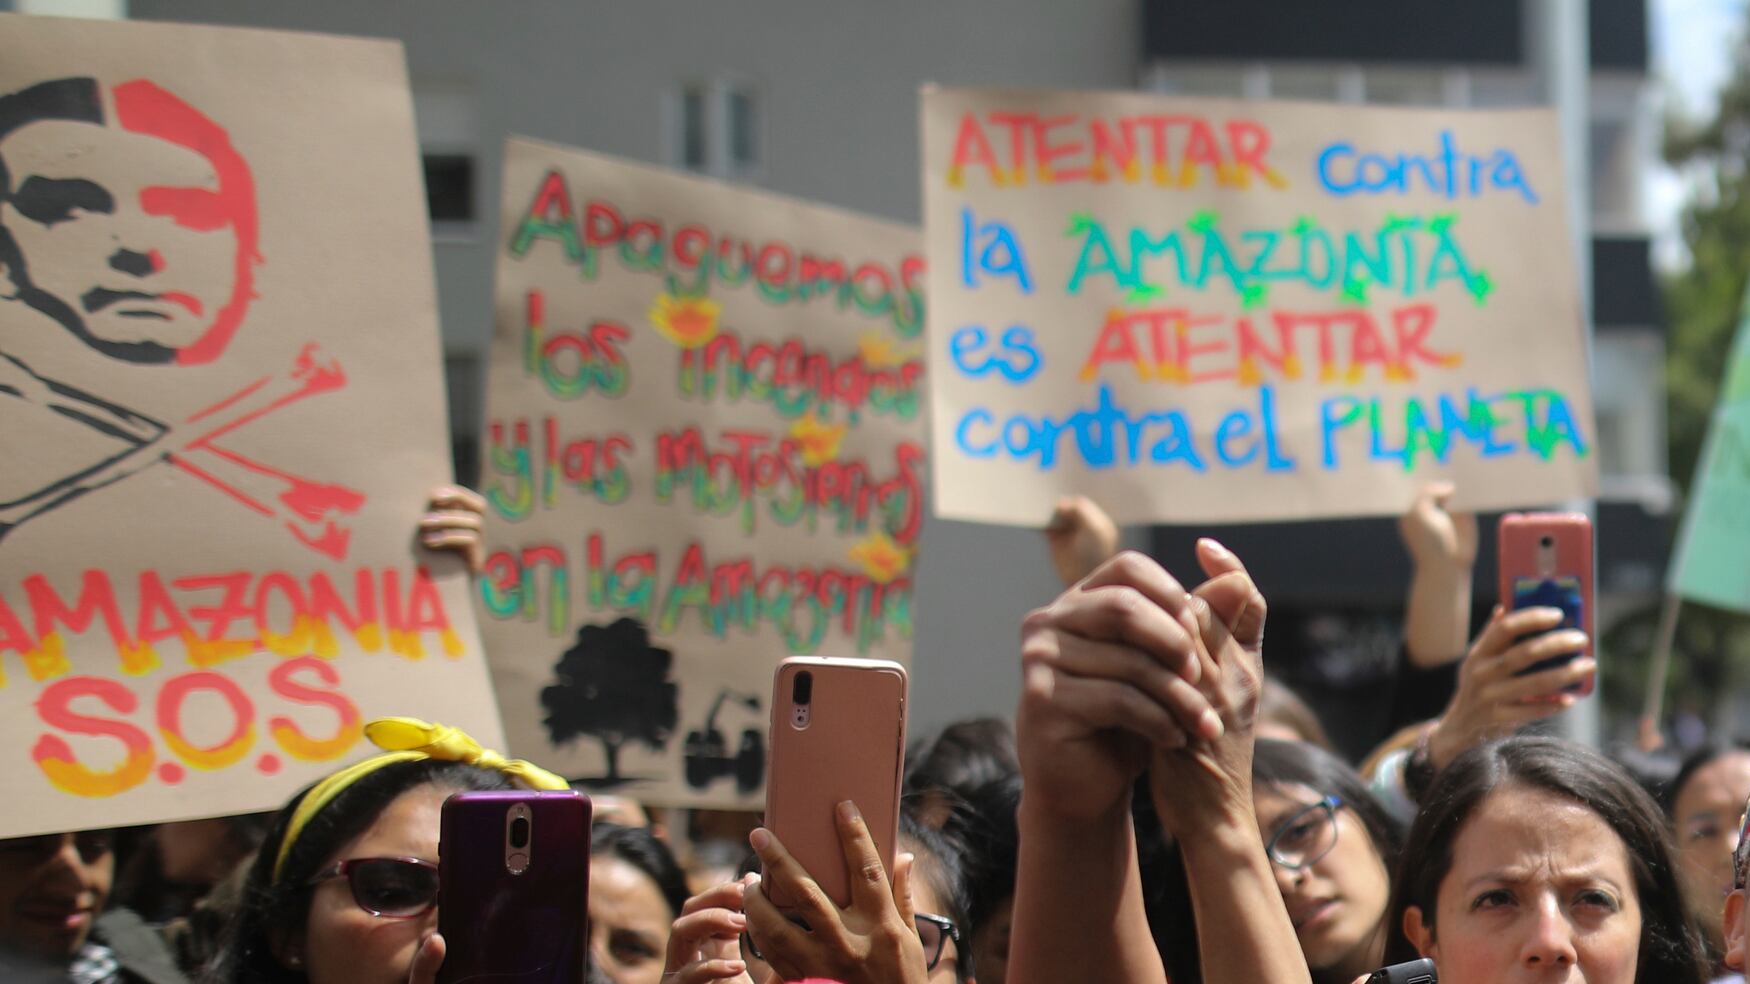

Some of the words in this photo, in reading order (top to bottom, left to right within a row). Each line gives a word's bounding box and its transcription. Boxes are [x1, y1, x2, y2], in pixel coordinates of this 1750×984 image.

[947, 110, 1291, 192] ATENTAR
[508, 169, 928, 339] Apaguemos
[961, 208, 1034, 295] la
[524, 289, 632, 399] los
[949, 325, 1044, 386] es
[1078, 305, 1465, 388] ATENTAR
[1320, 388, 1593, 474] PLANETA
[480, 544, 568, 637] en
[587, 532, 657, 618] la
